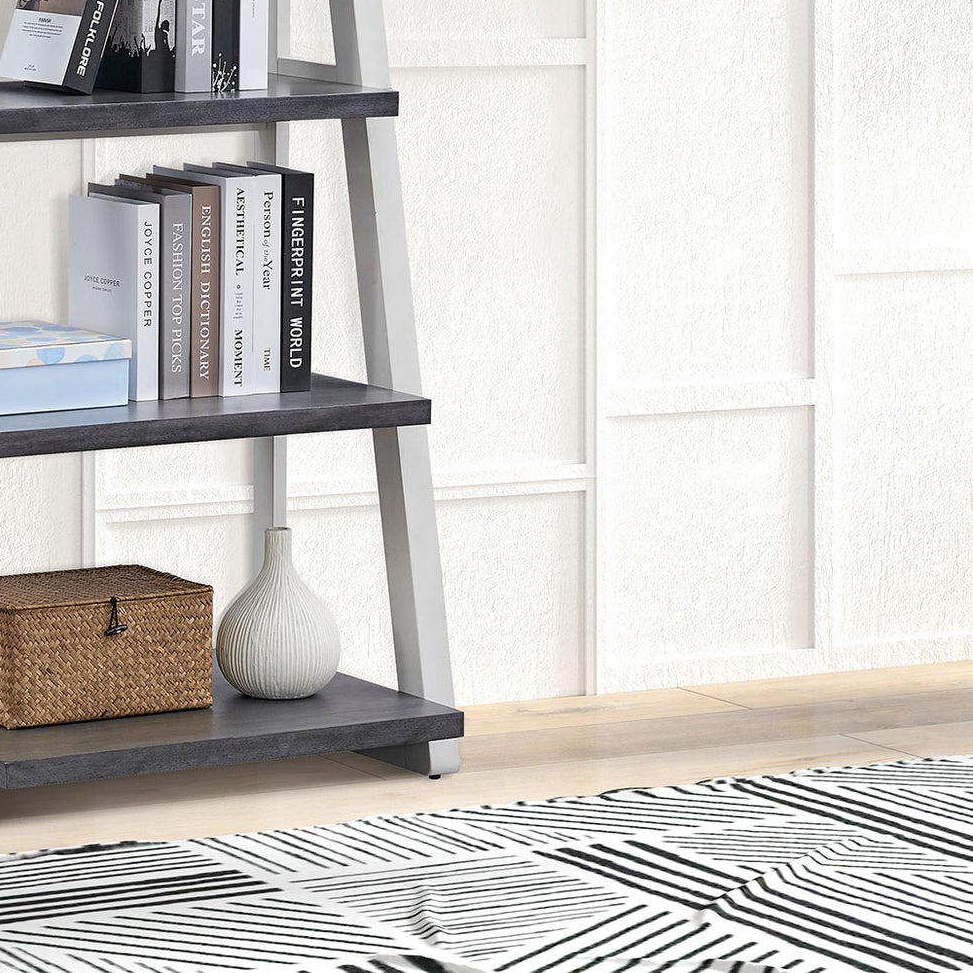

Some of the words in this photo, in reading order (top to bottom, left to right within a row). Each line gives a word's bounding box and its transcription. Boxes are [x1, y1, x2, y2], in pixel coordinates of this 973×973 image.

[76, 0, 105, 77] FOLKLORE
[143, 221, 153, 265] JOYCE
[200, 204, 212, 274] ENGLISH
[235, 187, 245, 276] AESTHETICAL
[263, 192, 273, 238] Person
[172, 222, 184, 291] FASHION
[262, 260, 273, 290] Year
[290, 197, 305, 307] FINGERPRINT
[143, 271, 152, 327] COPPER
[172, 294, 184, 324] TOP
[171, 327, 182, 374] PICKS
[199, 282, 211, 380] DICTIONARY
[234, 329, 243, 387] MOMENT
[289, 317, 304, 369] WORLD
